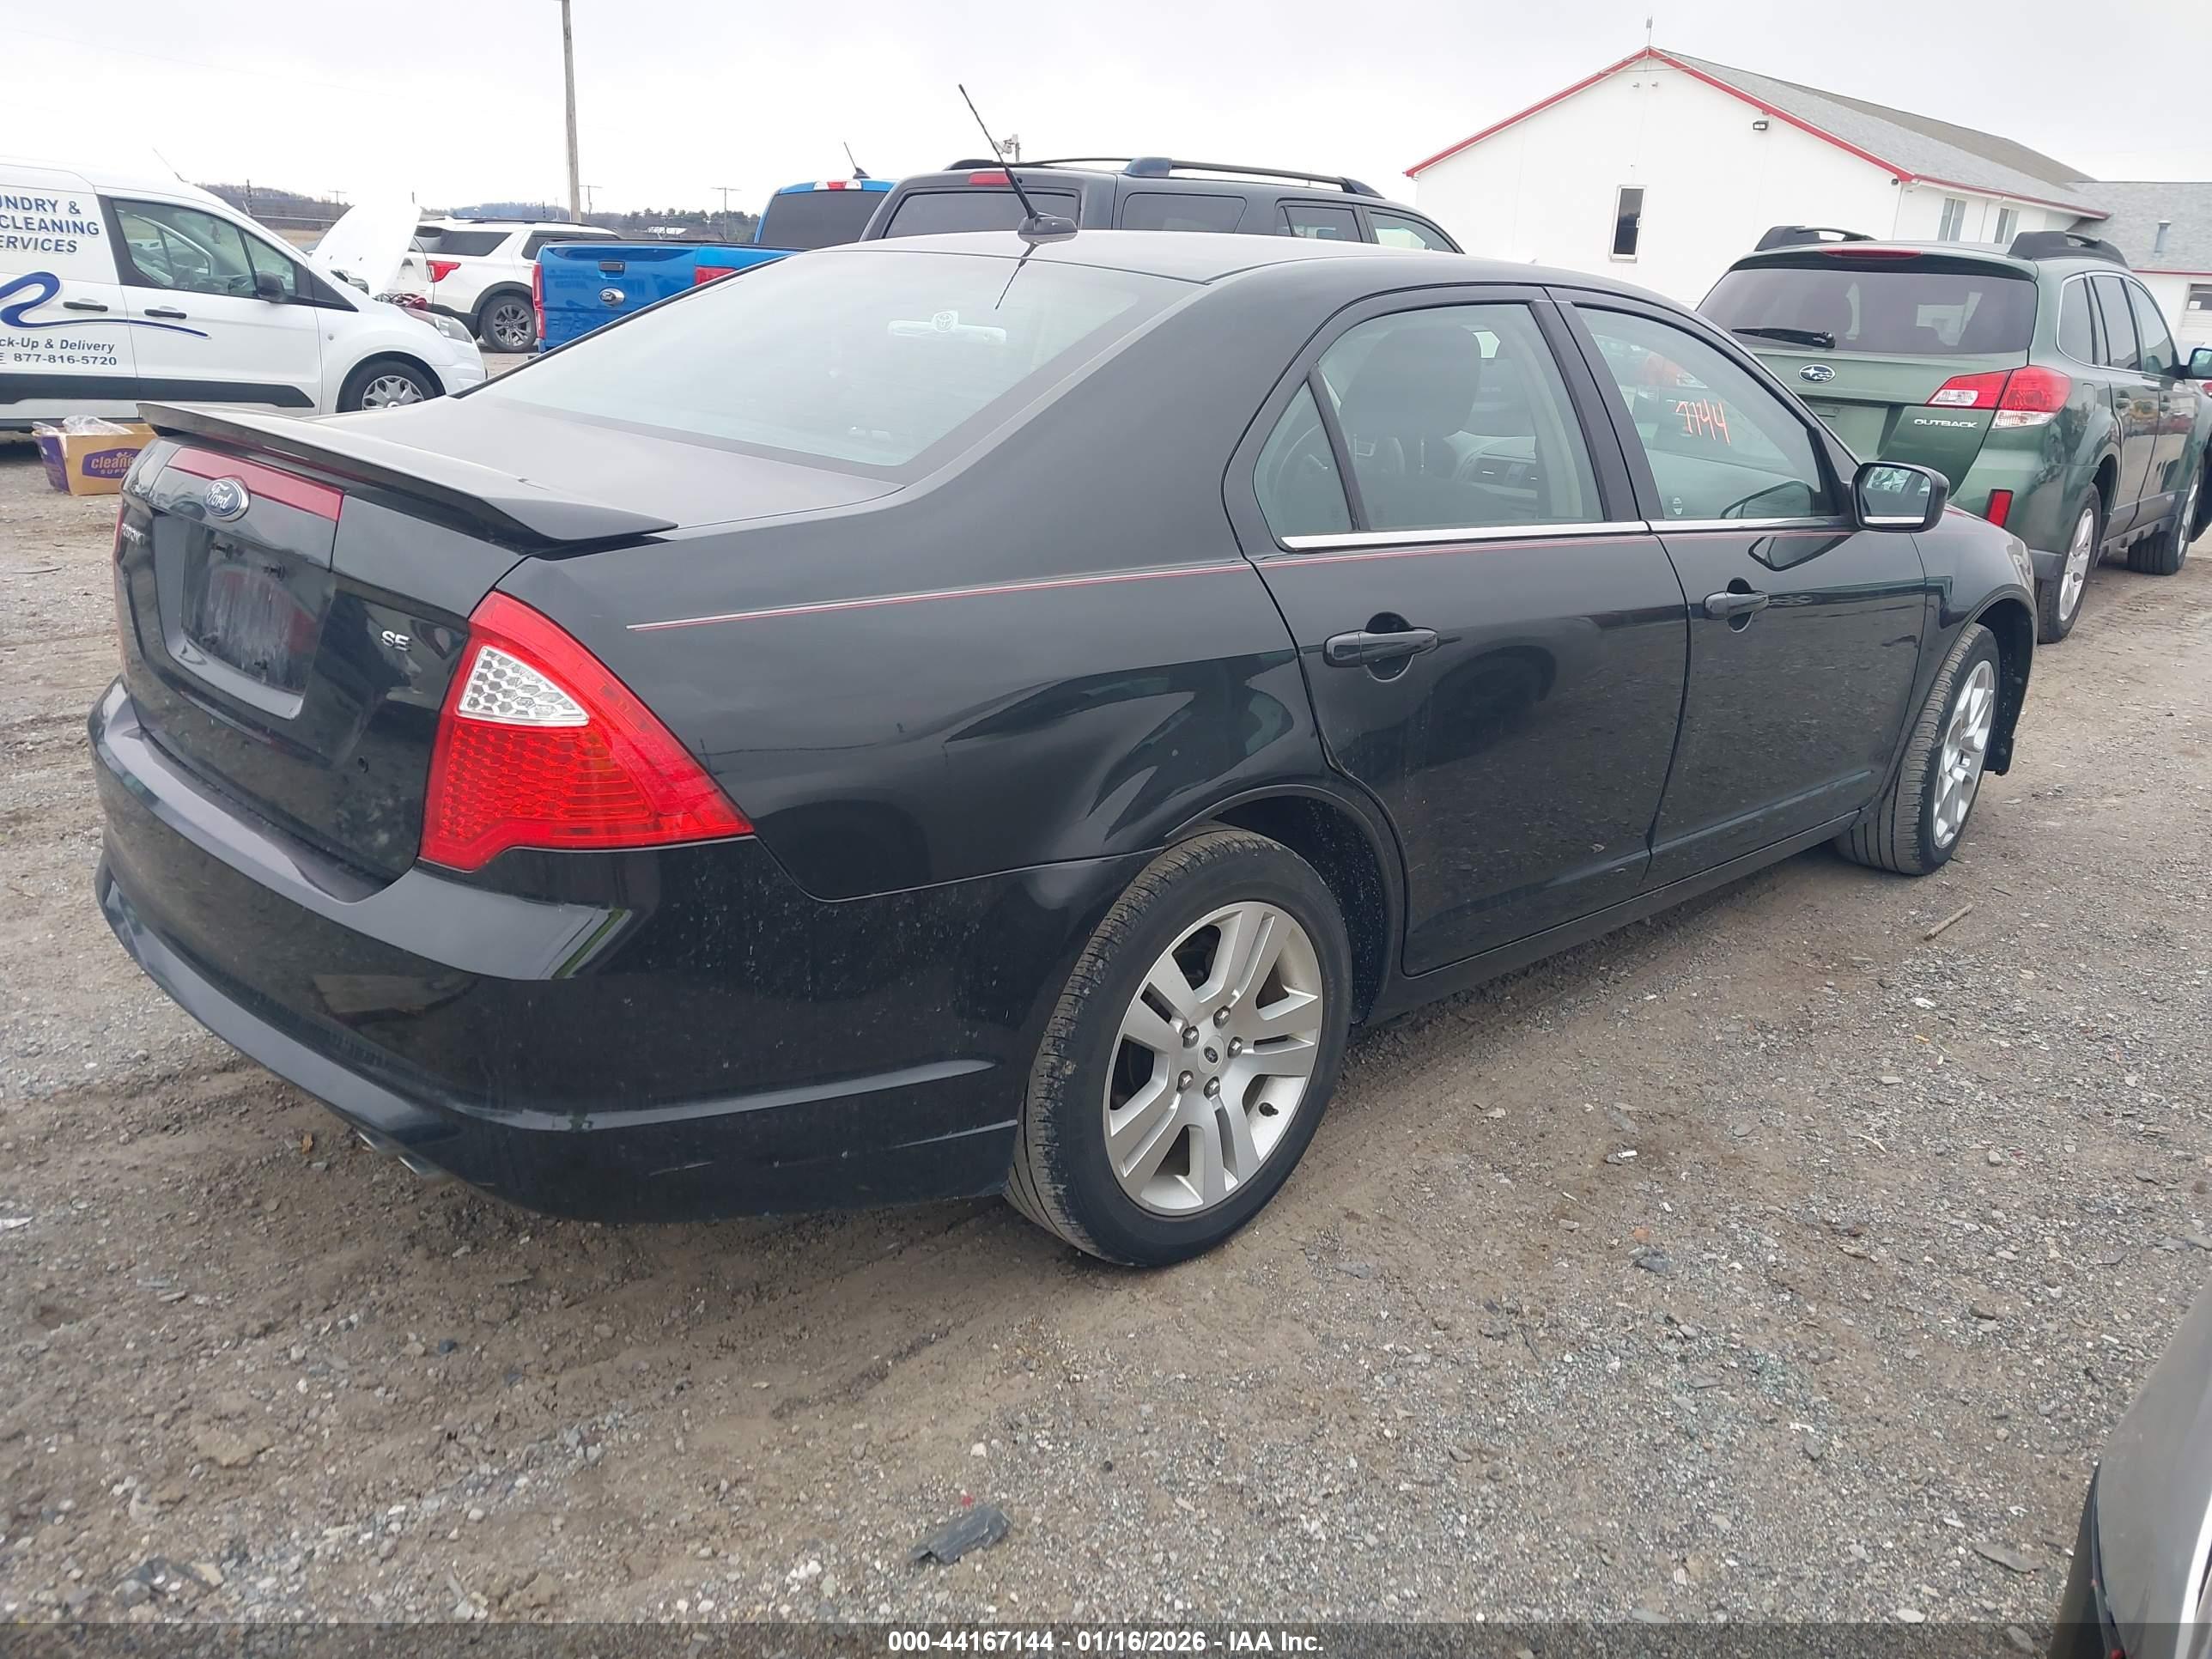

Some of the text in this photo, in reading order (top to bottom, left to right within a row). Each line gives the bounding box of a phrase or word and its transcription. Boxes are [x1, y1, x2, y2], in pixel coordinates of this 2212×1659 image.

[0, 195, 82, 215] NDRY &
[0, 215, 100, 235] CLEANING
[44, 338, 54, 349] &
[60, 339, 115, 354] Delivery
[14, 353, 117, 366] 877-816-5720
[1913, 418, 1978, 428] OUTBACK
[206, 482, 234, 510] Ford
[380, 630, 410, 652] SE
